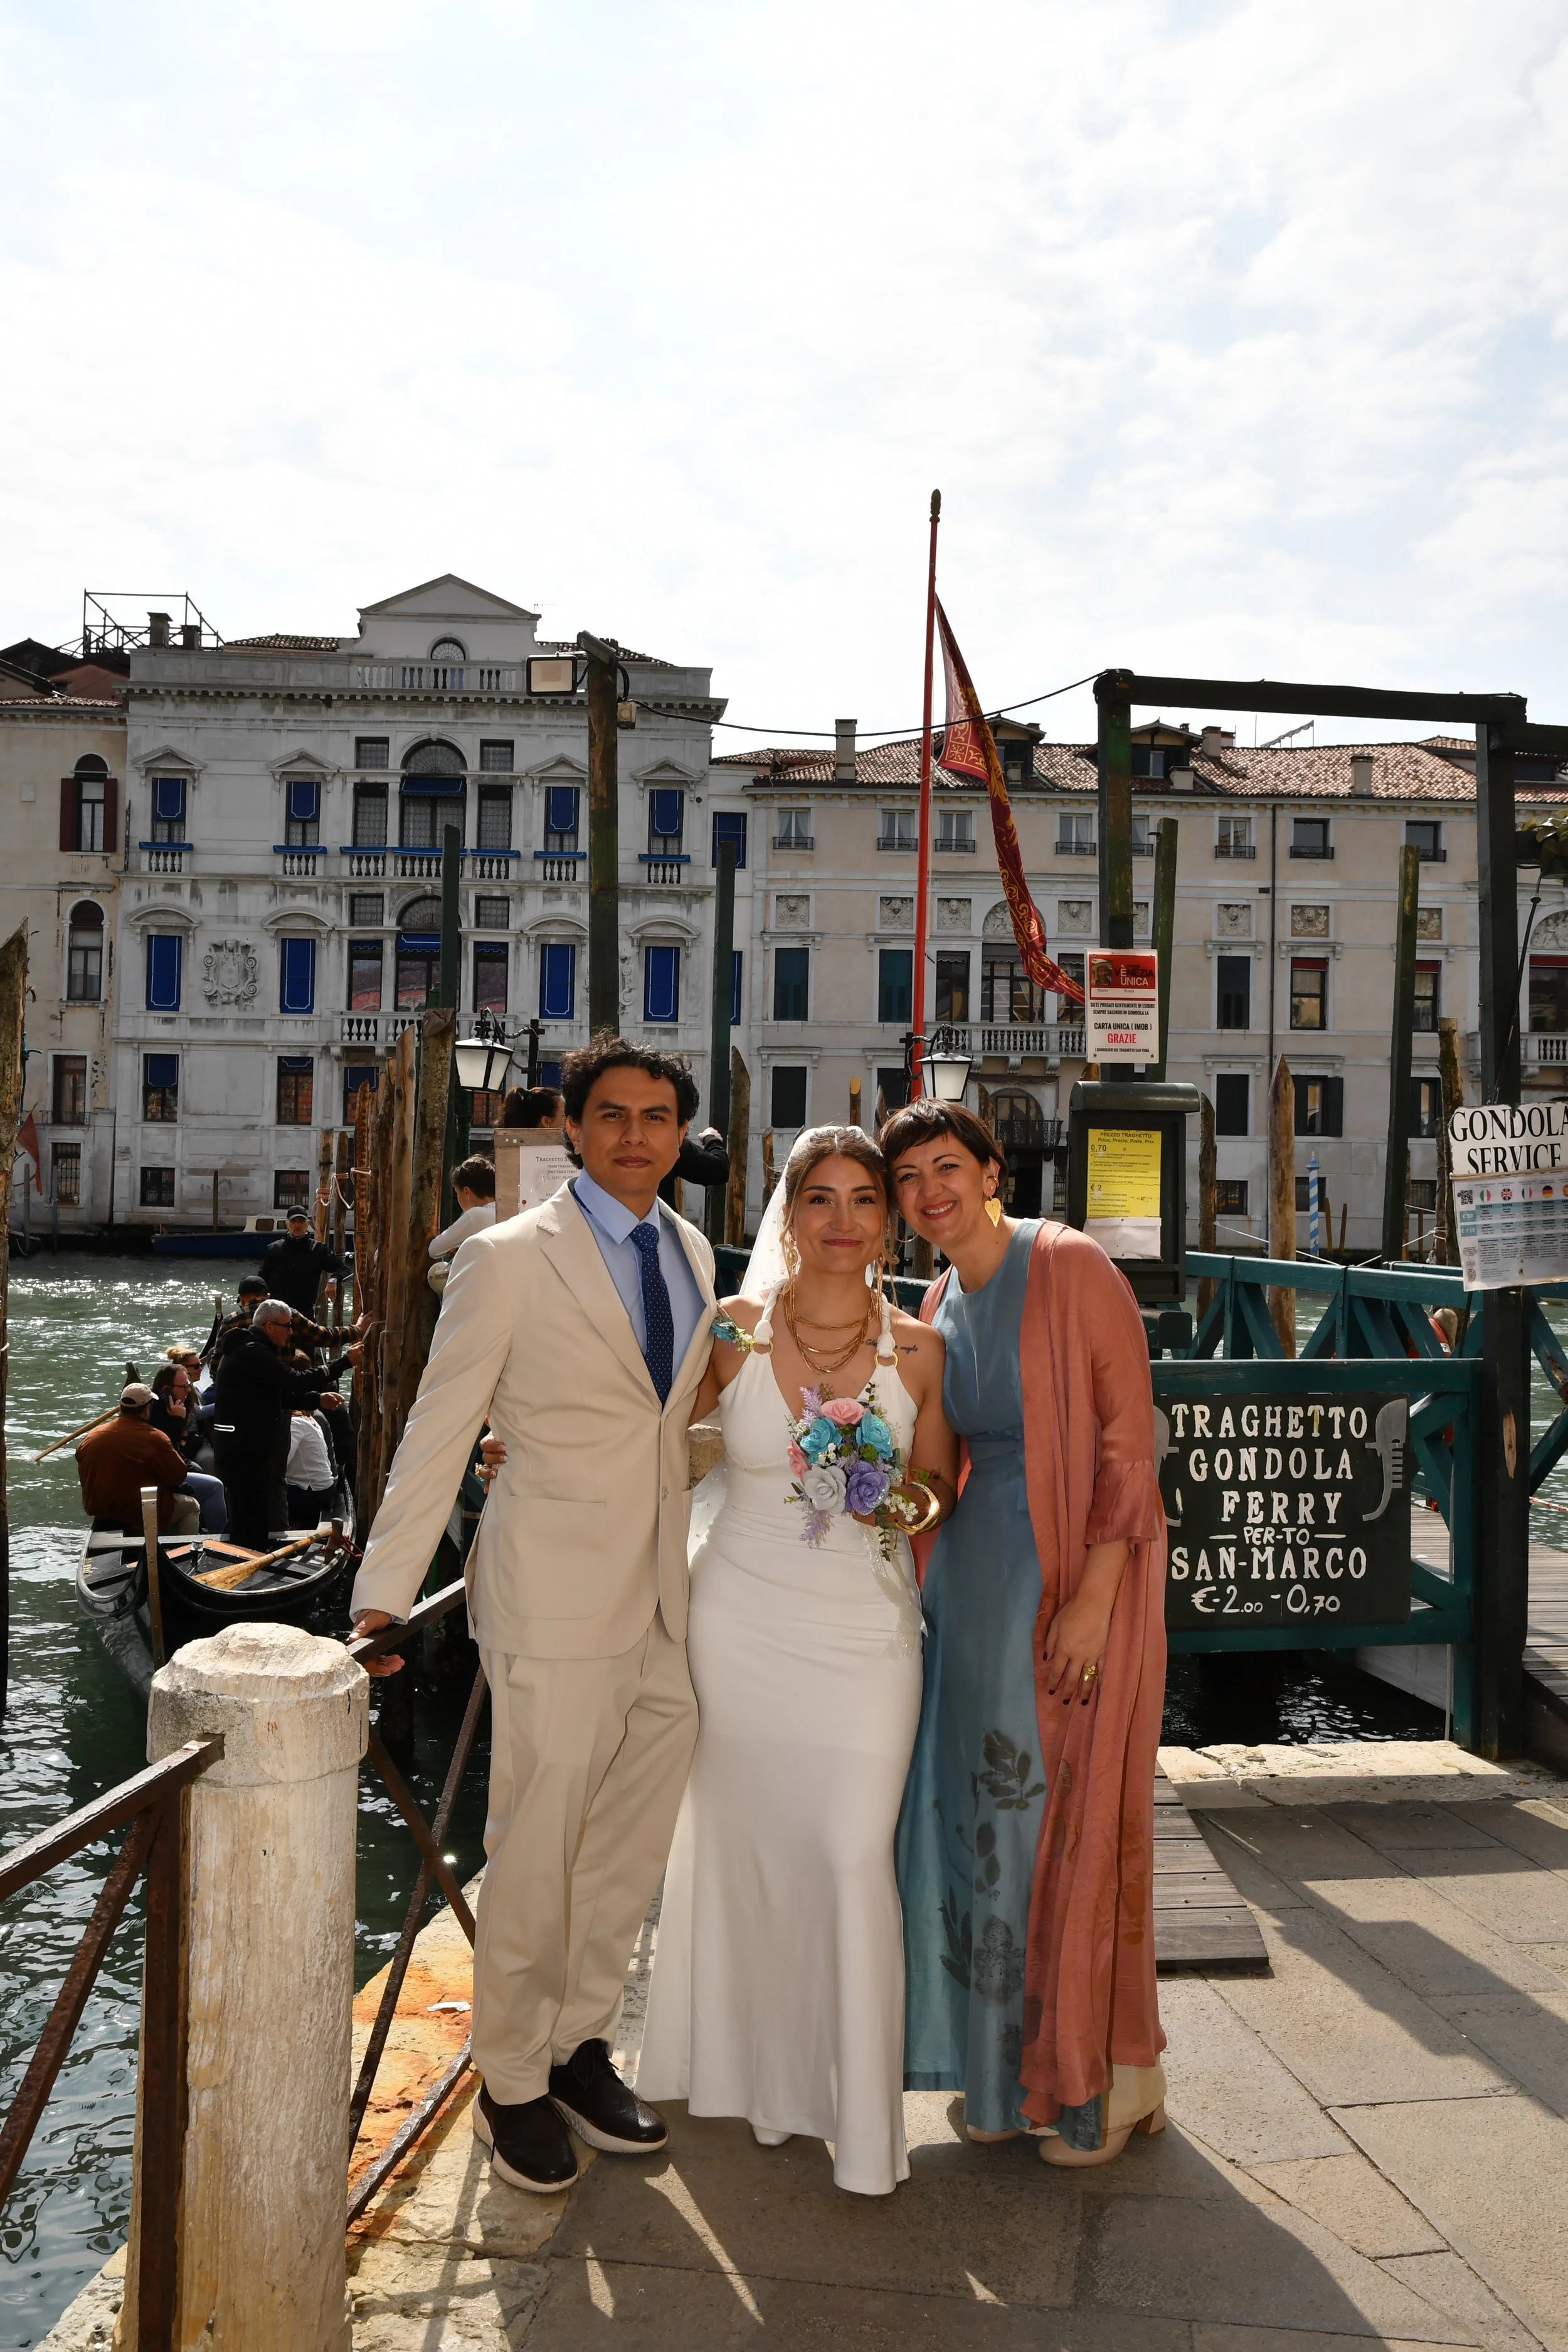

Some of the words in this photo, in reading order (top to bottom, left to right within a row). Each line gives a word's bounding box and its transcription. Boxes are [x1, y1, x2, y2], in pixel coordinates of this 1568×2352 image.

[1120, 977, 1149, 986] UNICA
[1107, 1033, 1136, 1044] GRAZIE
[1467, 1143, 1561, 1174] SERVICE
[1171, 1403, 1367, 1439] TRAGHETTO
[1189, 1447, 1353, 1481] GONDOLA
[1221, 1490, 1342, 1525] FERRY
